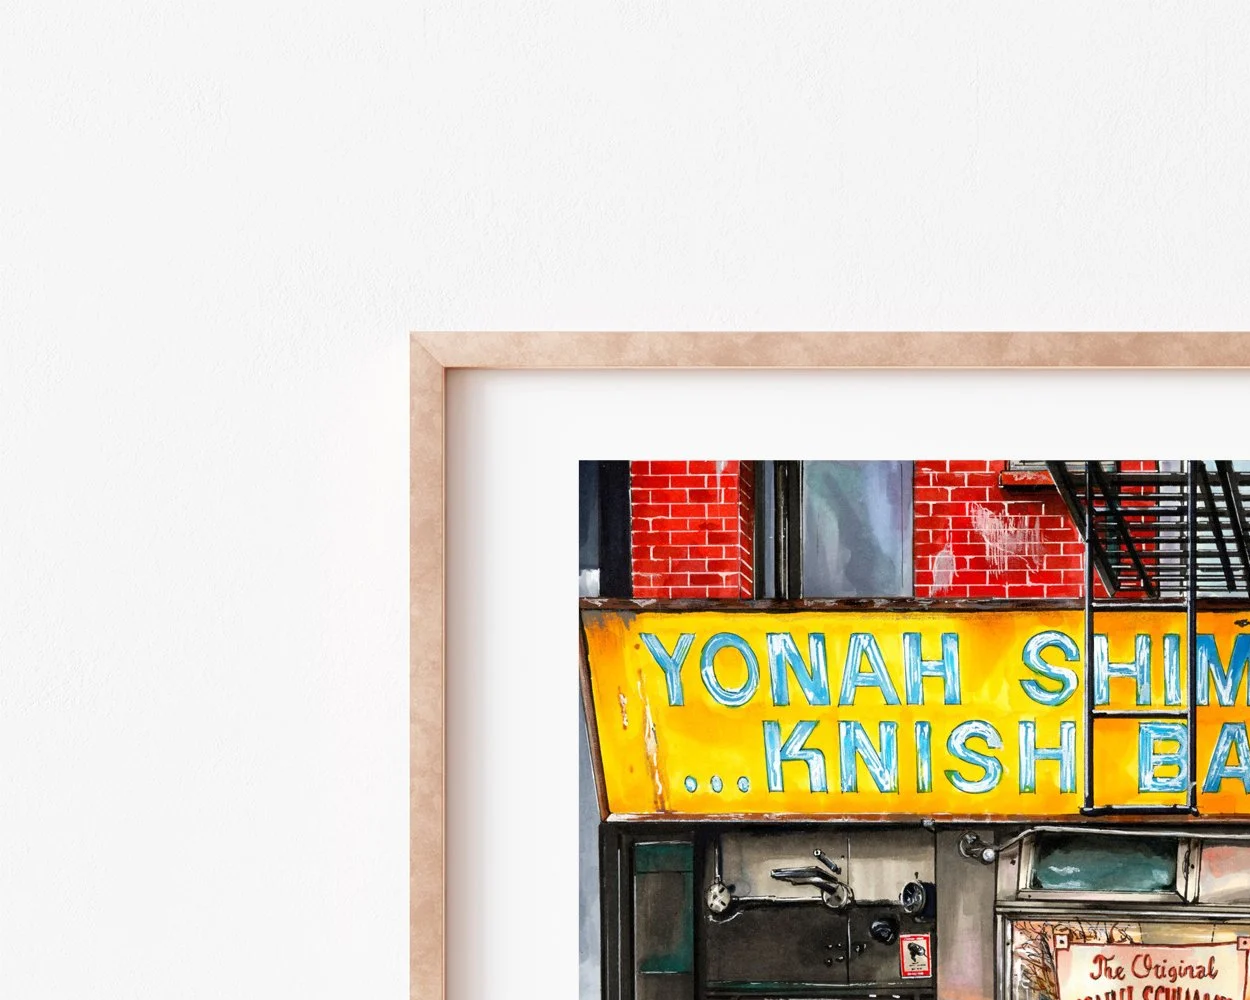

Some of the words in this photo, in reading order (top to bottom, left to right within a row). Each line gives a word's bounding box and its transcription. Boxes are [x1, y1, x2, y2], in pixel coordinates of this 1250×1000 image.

[639, 631, 962, 708] YONAH
[1089, 953, 1125, 981] The
[1131, 953, 1219, 983] Original
